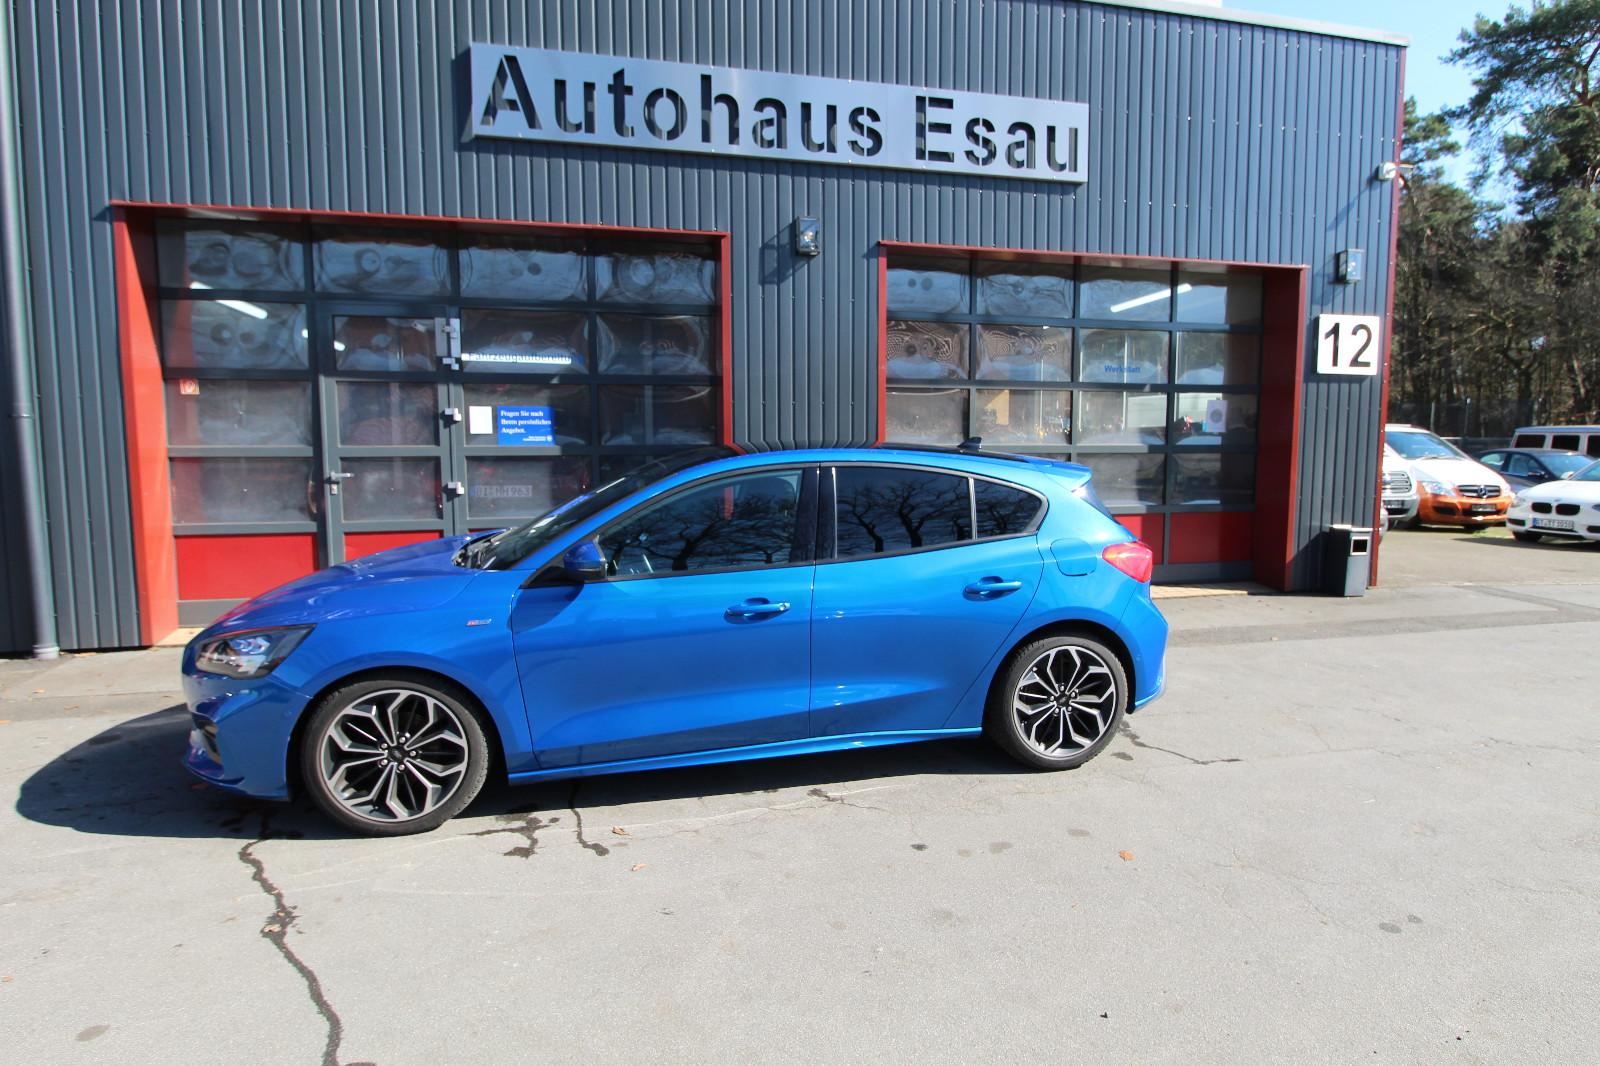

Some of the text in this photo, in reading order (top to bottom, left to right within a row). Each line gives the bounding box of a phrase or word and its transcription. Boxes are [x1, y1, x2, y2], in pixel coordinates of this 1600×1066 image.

[480, 54, 1079, 174] Autohaus Esau
[1323, 322, 1373, 368] 12
[1104, 364, 1141, 373] Werktatt
